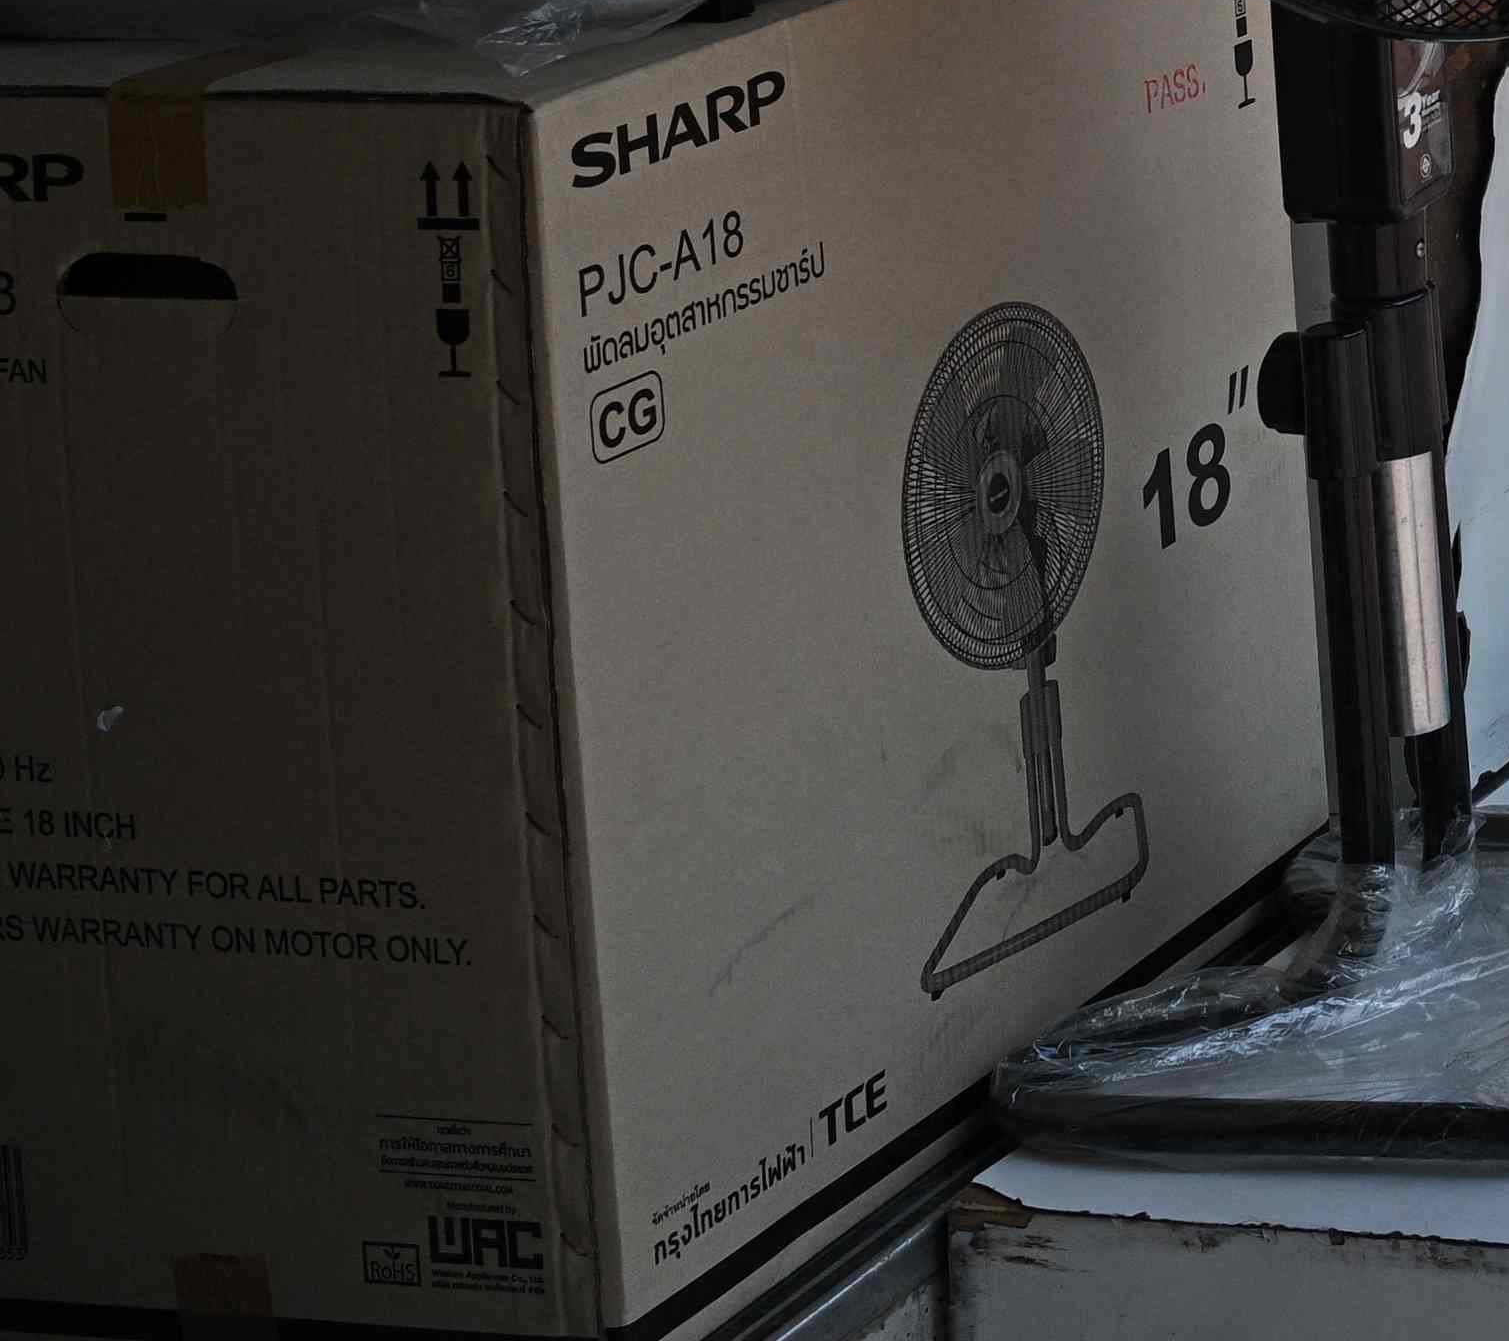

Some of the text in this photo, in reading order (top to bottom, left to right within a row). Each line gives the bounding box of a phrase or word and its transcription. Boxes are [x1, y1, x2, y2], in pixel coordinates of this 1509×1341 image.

[570, 69, 786, 189] SHARP
[1397, 90, 1423, 150] 3
[578, 209, 745, 319] PJC-A18
[582, 240, 827, 374] พัดลมอุตสาหกรรมชาร์ป
[599, 387, 658, 449] CG
[15, 755, 54, 783] Hz
[23, 809, 137, 841] 18 INCH
[8, 861, 428, 911] WARRANTY FOR ALL PARTS.
[35, 916, 203, 951] WARRANTY
[210, 924, 257, 955] ON
[265, 927, 378, 963] MOTOR
[385, 932, 473, 967] ONLY.
[817, 1068, 889, 1148] TCE
[653, 1142, 807, 1266] กรุงไทยการไฟฟ้า
[369, 1260, 416, 1282] RoHS
